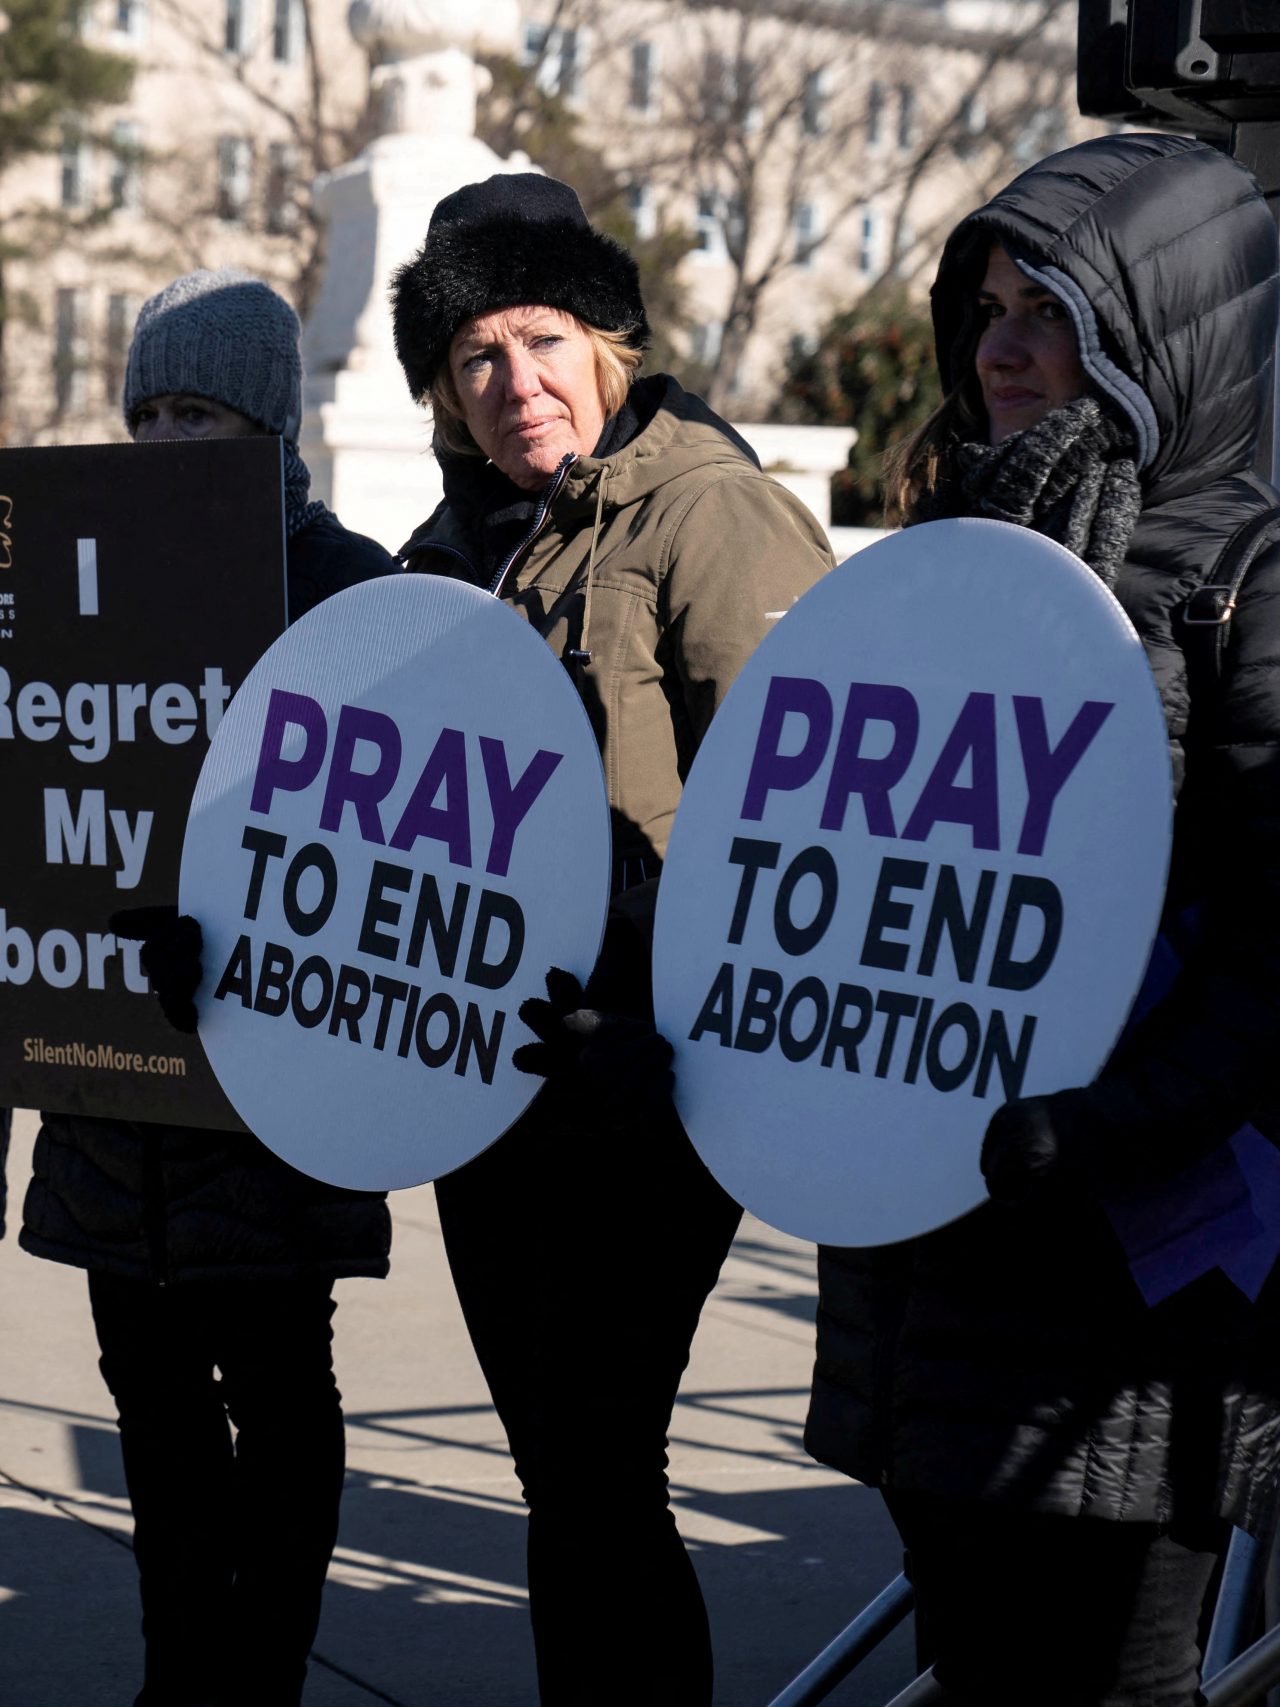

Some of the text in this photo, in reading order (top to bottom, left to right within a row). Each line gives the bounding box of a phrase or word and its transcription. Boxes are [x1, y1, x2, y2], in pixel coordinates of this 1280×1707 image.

[77, 537, 99, 616] I
[43, 787, 154, 889] My
[249, 688, 564, 877] PRAY
[739, 676, 1116, 857] PRAY
[241, 826, 525, 990] TO END
[727, 837, 1064, 992] TO END
[23, 1037, 186, 1076] SilentNoMore.com
[213, 935, 506, 1086] ABORTION
[687, 962, 1038, 1100] ABORTION
